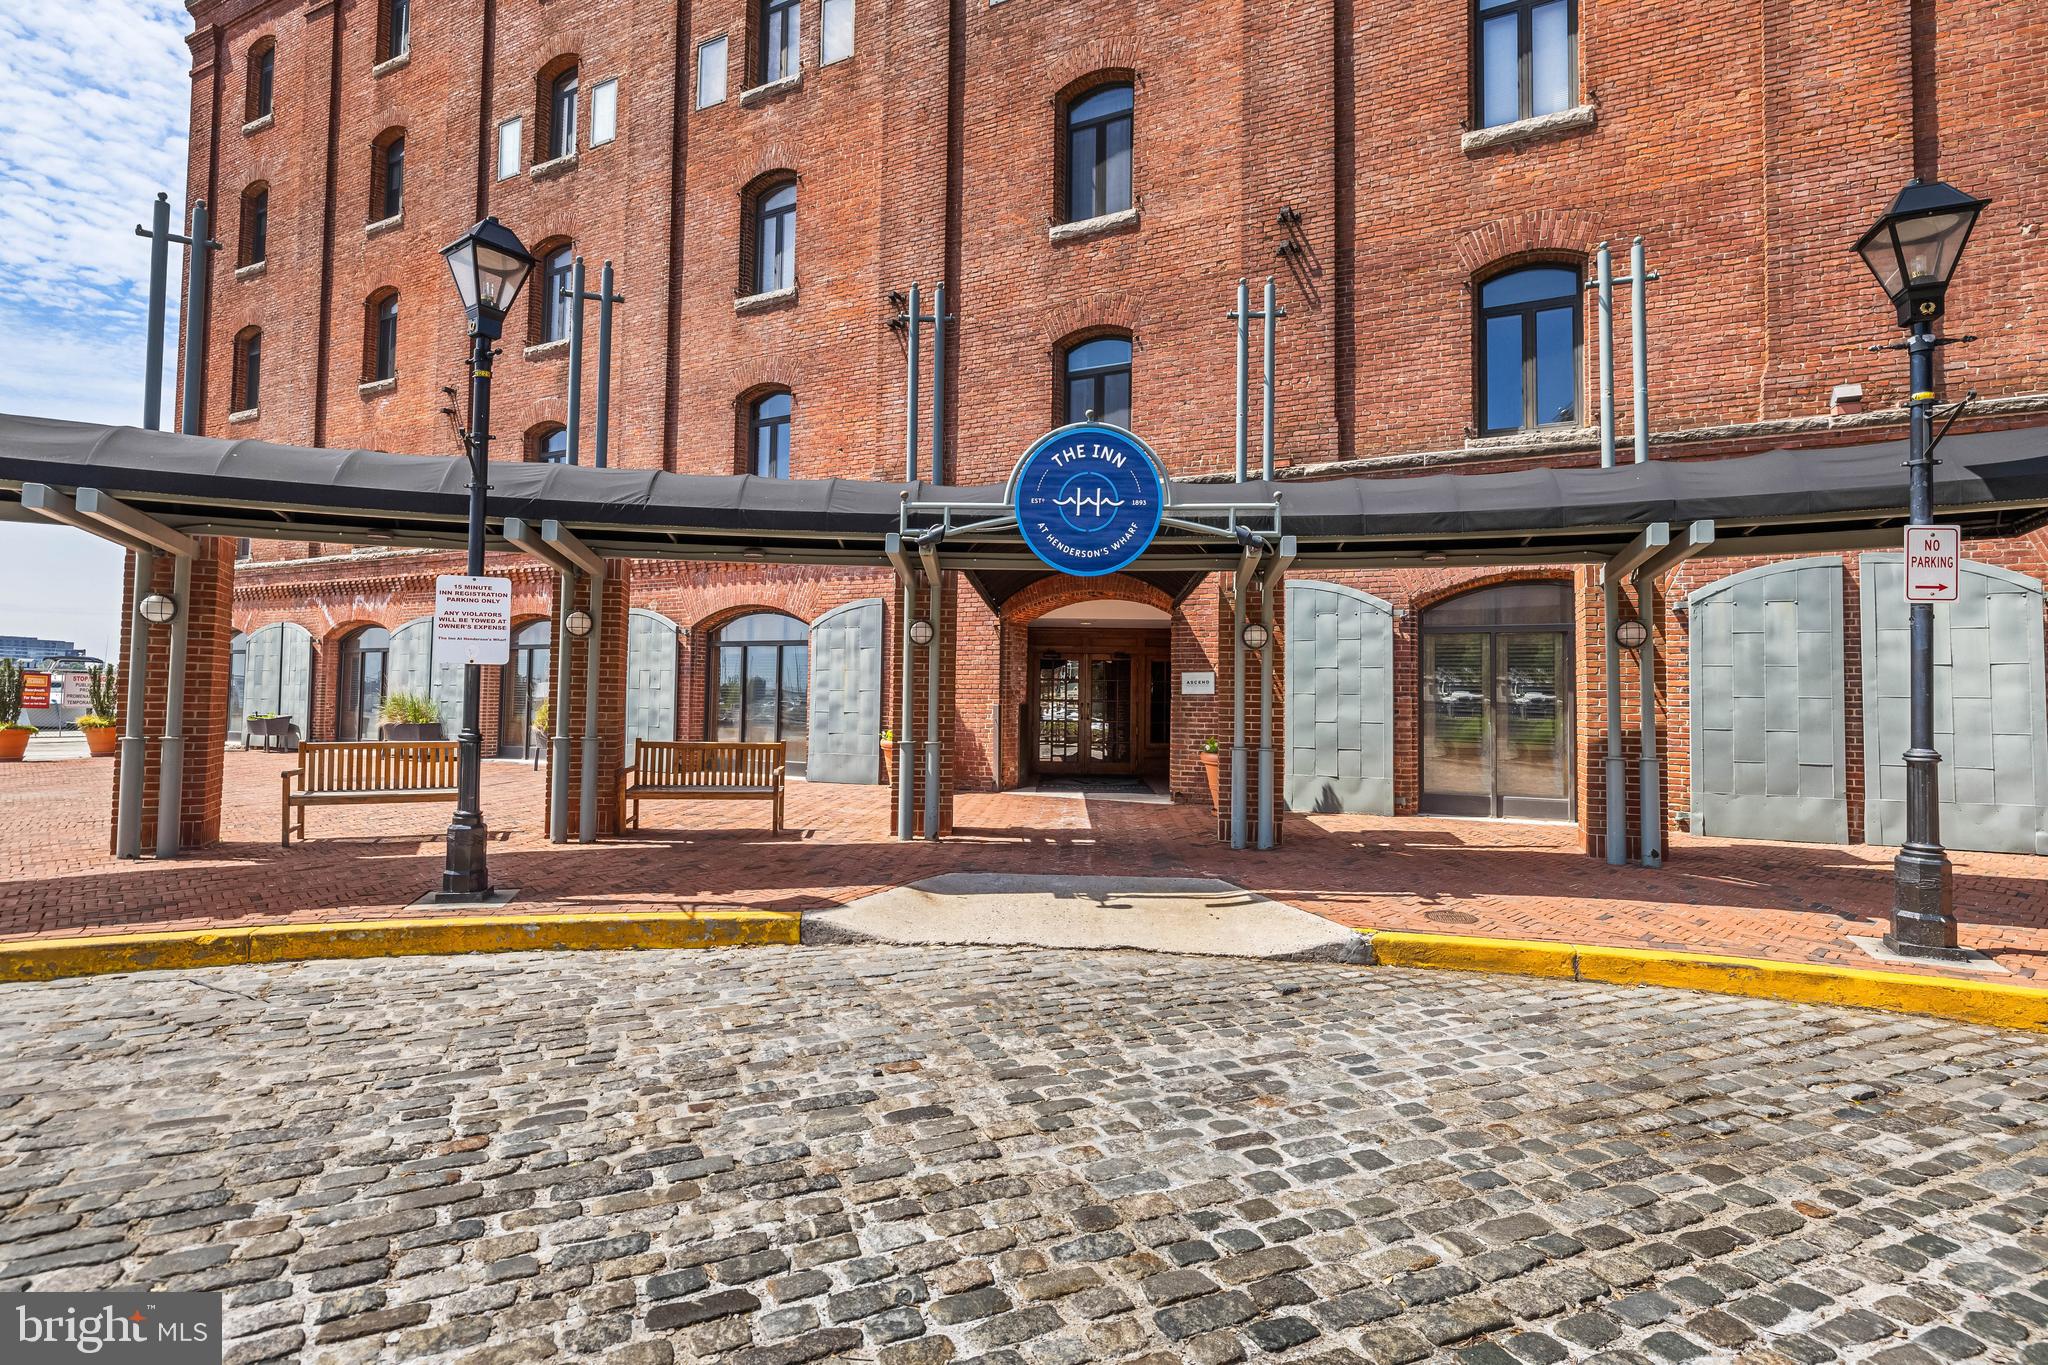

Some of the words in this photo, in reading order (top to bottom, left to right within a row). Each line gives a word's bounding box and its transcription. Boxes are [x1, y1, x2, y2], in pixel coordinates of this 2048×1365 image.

[1051, 444, 1086, 467] THE
[1092, 444, 1127, 468] INN
[1037, 522, 1049, 533] AT
[1046, 533, 1109, 558] HENDERSON'S
[1110, 522, 1139, 551] WHARF
[1925, 539, 1940, 551] NO
[1911, 556, 1954, 568] PARKING
